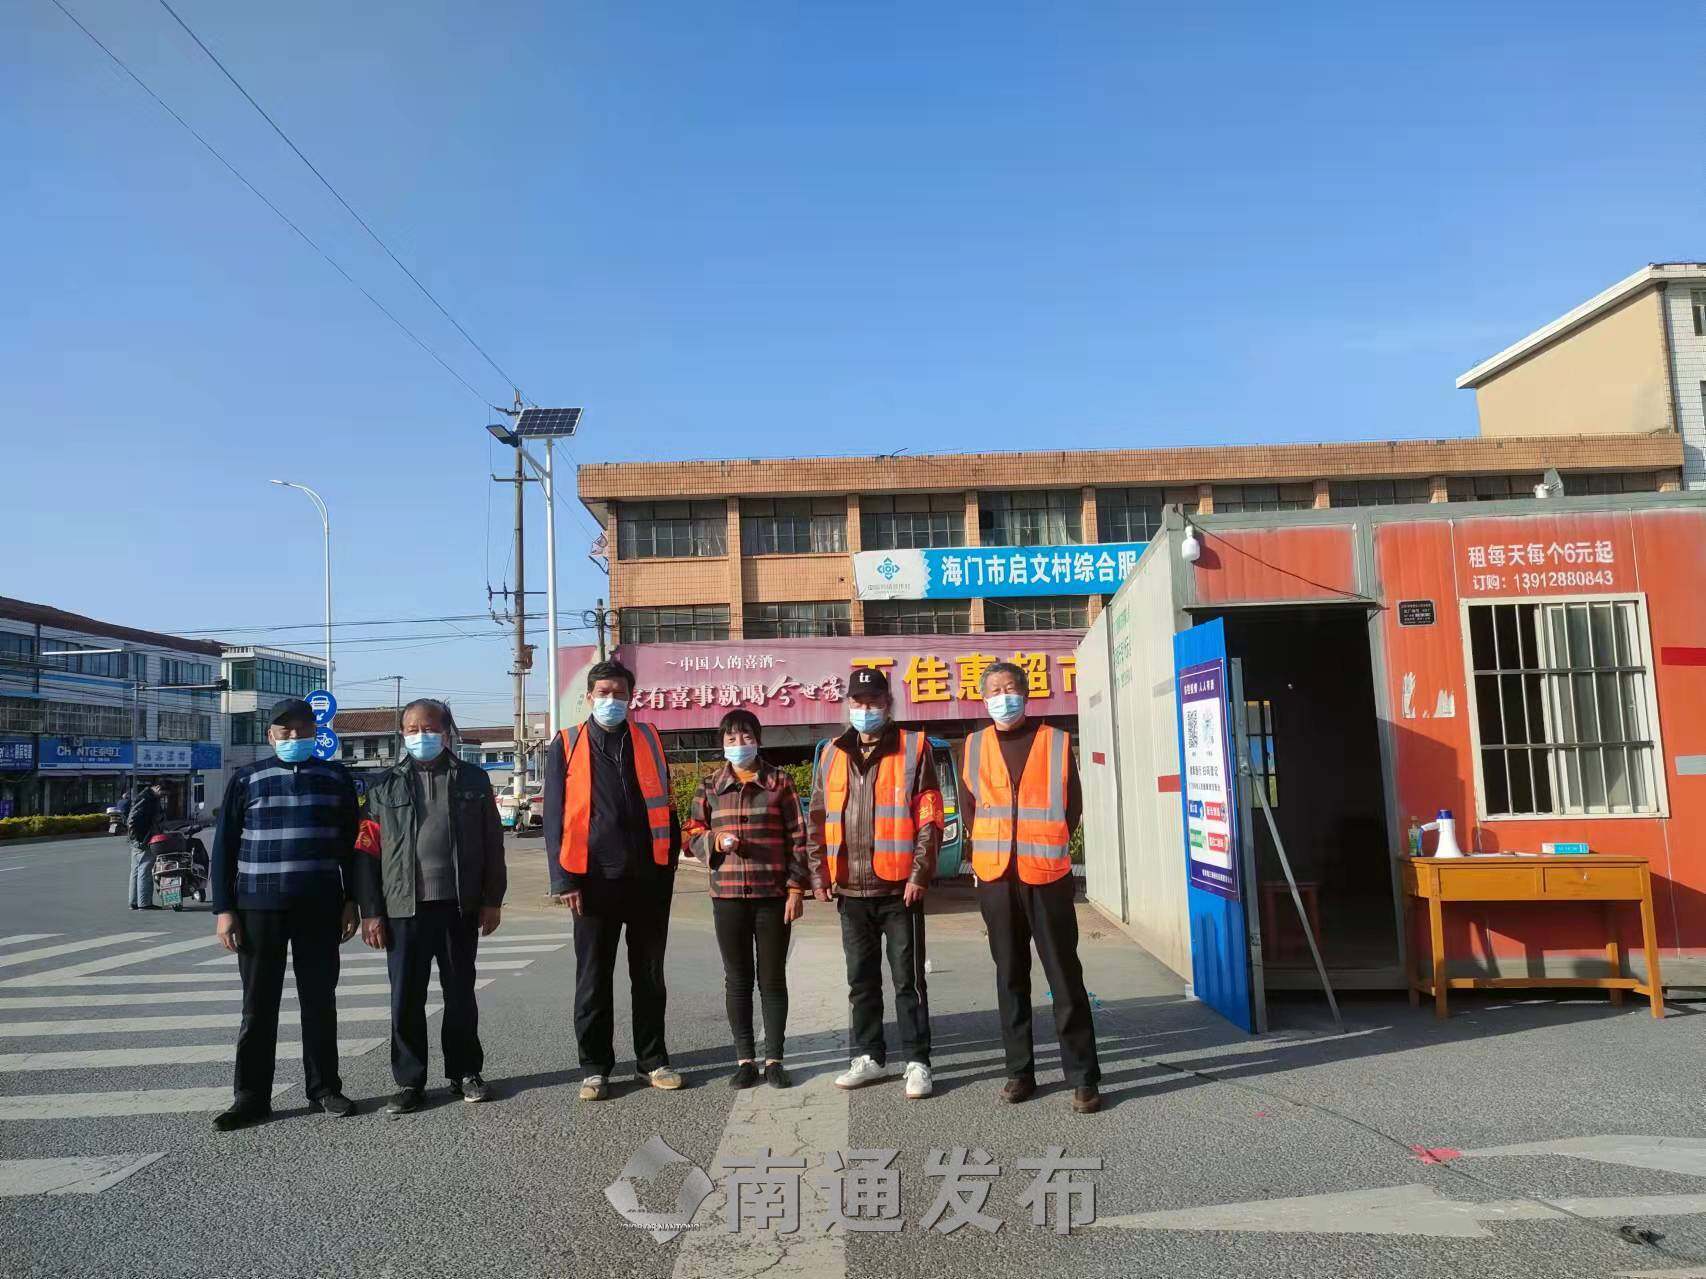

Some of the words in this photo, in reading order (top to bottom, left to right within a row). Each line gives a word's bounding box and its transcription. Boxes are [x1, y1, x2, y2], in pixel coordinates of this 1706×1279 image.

[942, 551, 1136, 586] 海门市启文村综合服
[1468, 541, 1614, 569] 租每天每个6元起
